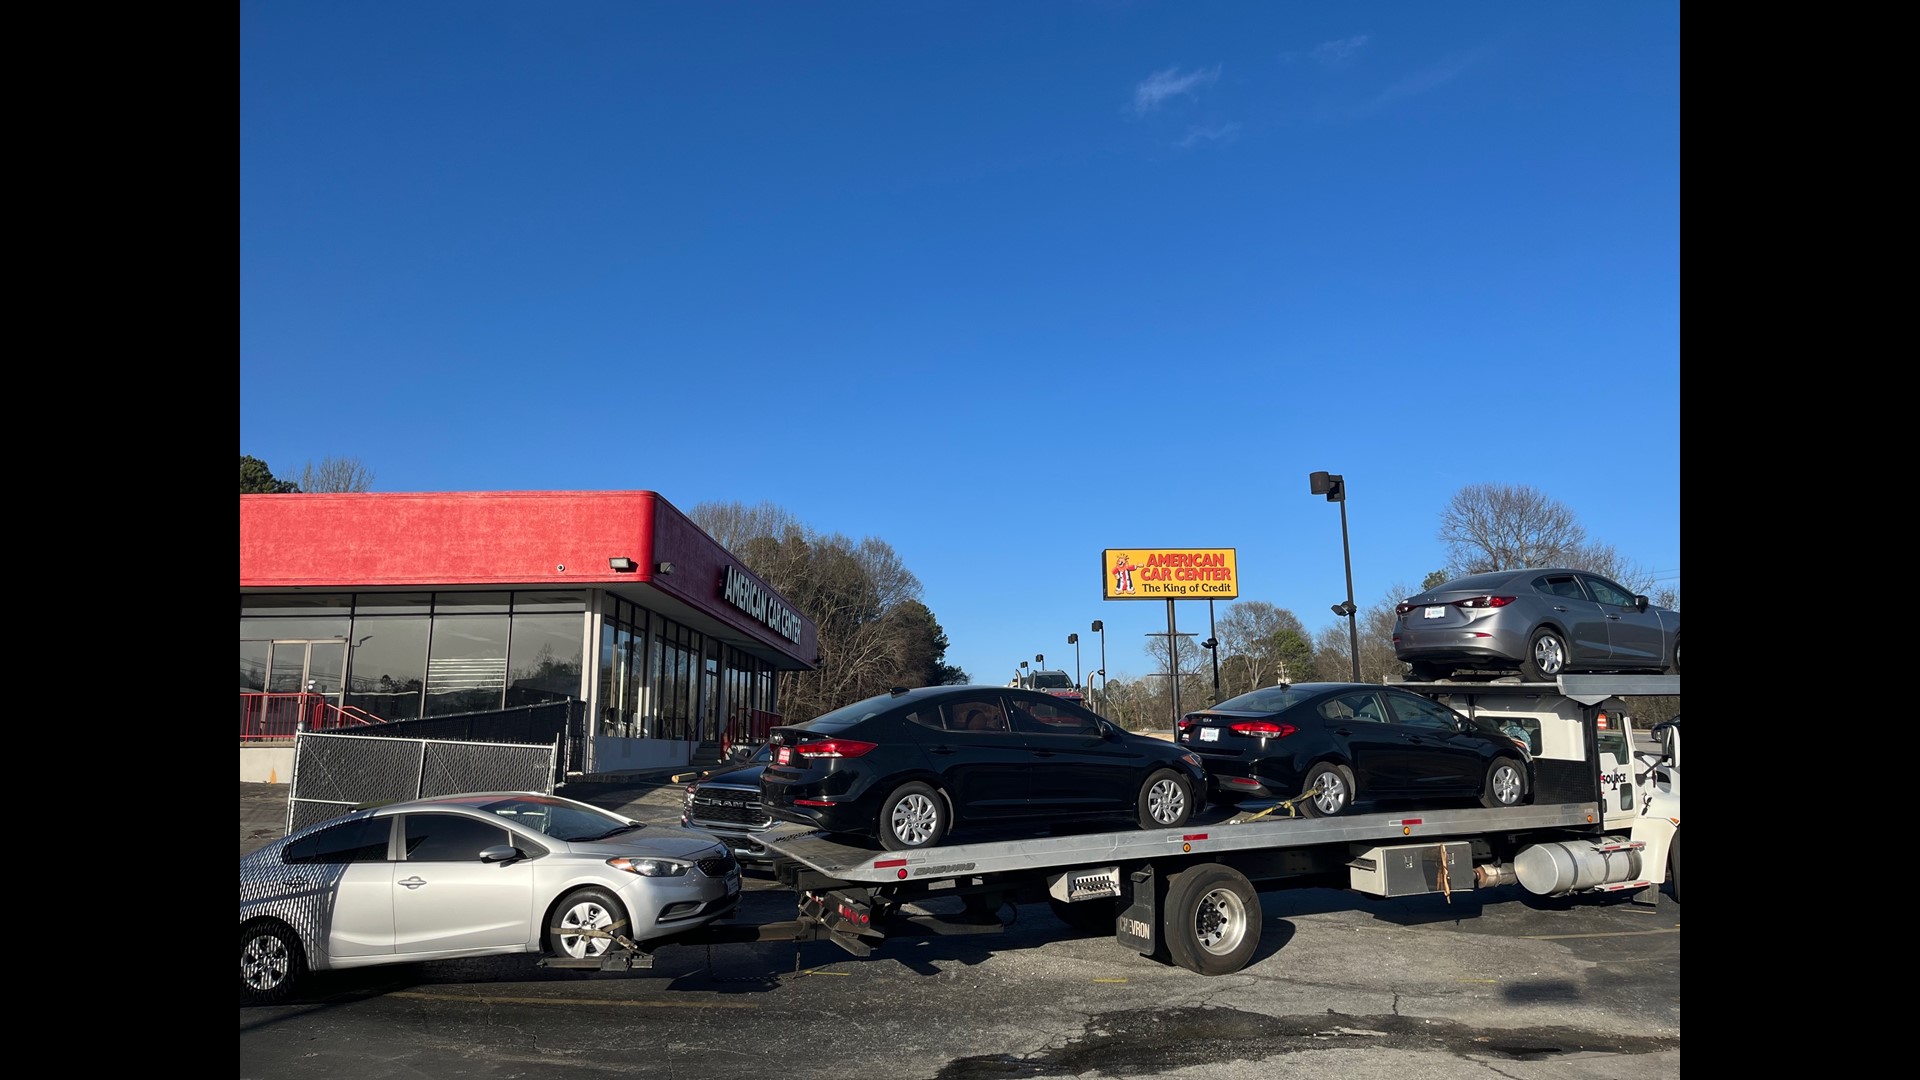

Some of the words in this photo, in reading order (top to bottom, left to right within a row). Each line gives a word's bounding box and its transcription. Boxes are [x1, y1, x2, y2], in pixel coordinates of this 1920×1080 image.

[1146, 553, 1225, 567] AMERICAN
[1140, 567, 1172, 581] CAR
[1175, 567, 1231, 581] CENTER
[1142, 583, 1161, 592] The
[1163, 583, 1186, 594] King
[1189, 583, 1200, 592] of
[1201, 583, 1231, 592] Credit
[724, 565, 767, 624] AMERICAN
[767, 597, 782, 633] CAR
[781, 607, 802, 646] CENTER
[1603, 773, 1626, 784] SOURCE
[712, 799, 744, 808] RAM
